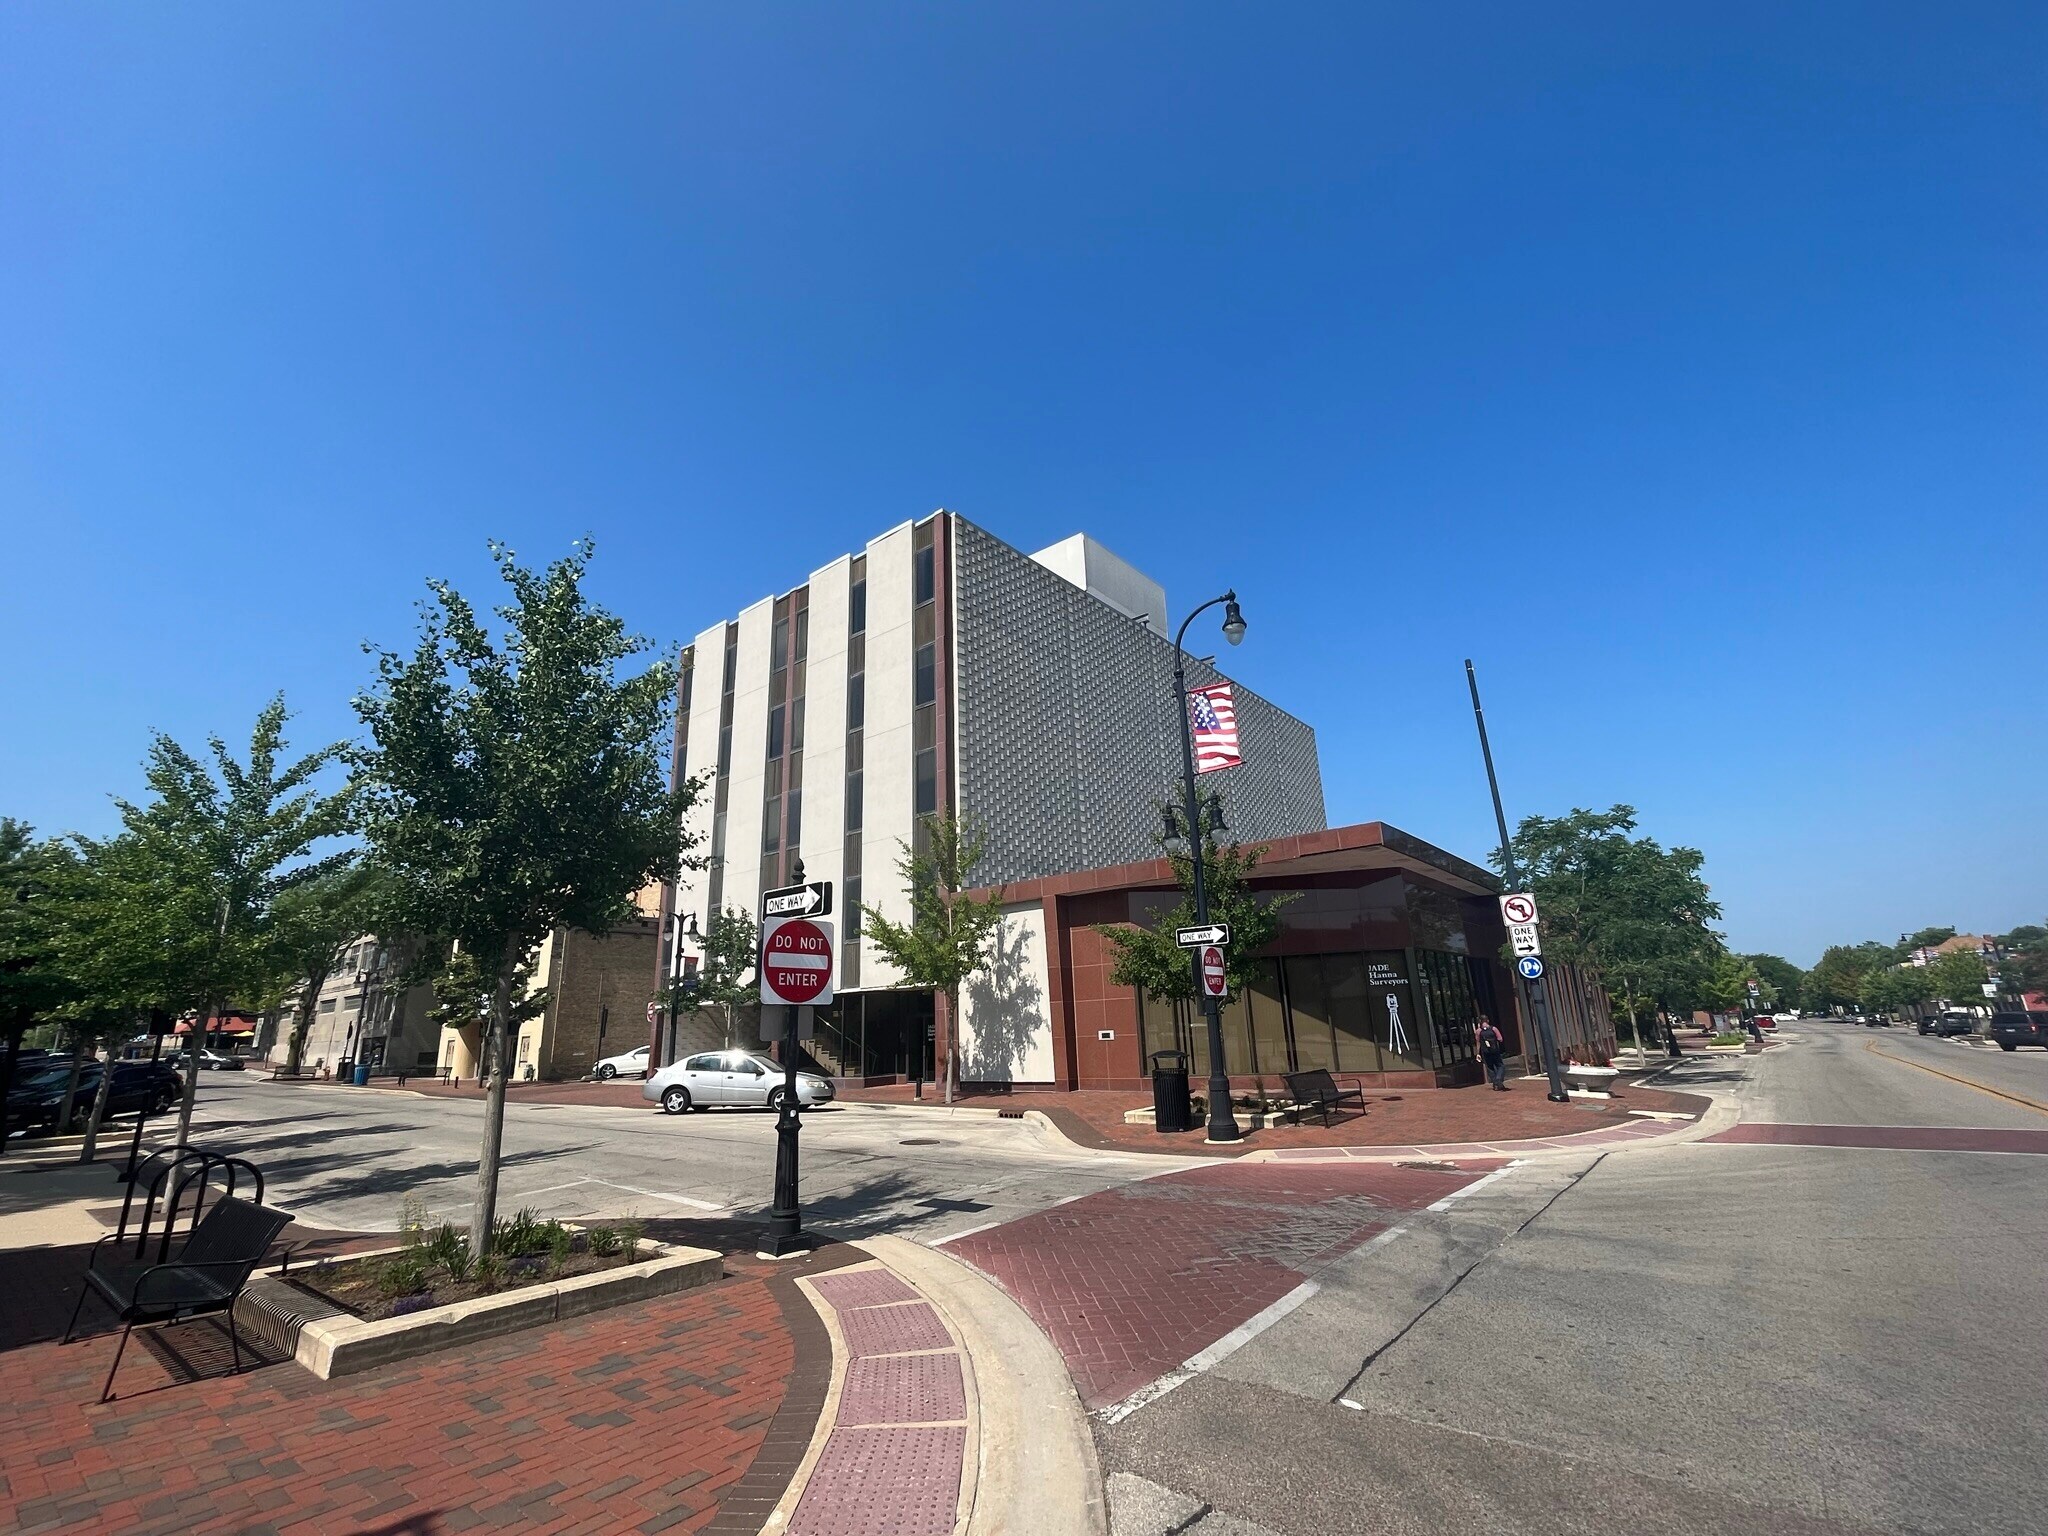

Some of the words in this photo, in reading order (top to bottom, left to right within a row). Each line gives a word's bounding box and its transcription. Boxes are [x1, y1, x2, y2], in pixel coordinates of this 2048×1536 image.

[768, 898, 785, 912] ONE
[787, 894, 805, 909] WAY
[1514, 927, 1533, 936] ONE
[1181, 933, 1195, 941] ONE
[1197, 932, 1212, 940] WAY
[1515, 935, 1534, 944] WAY
[776, 935, 793, 948] DO
[800, 936, 824, 950] NOT
[1206, 956, 1212, 964] DO
[1368, 964, 1390, 972] JADE
[778, 972, 818, 987] ENTER
[1369, 971, 1398, 979] Hanna
[1209, 977, 1222, 985] ENTER
[1369, 978, 1409, 987] Surveyors
